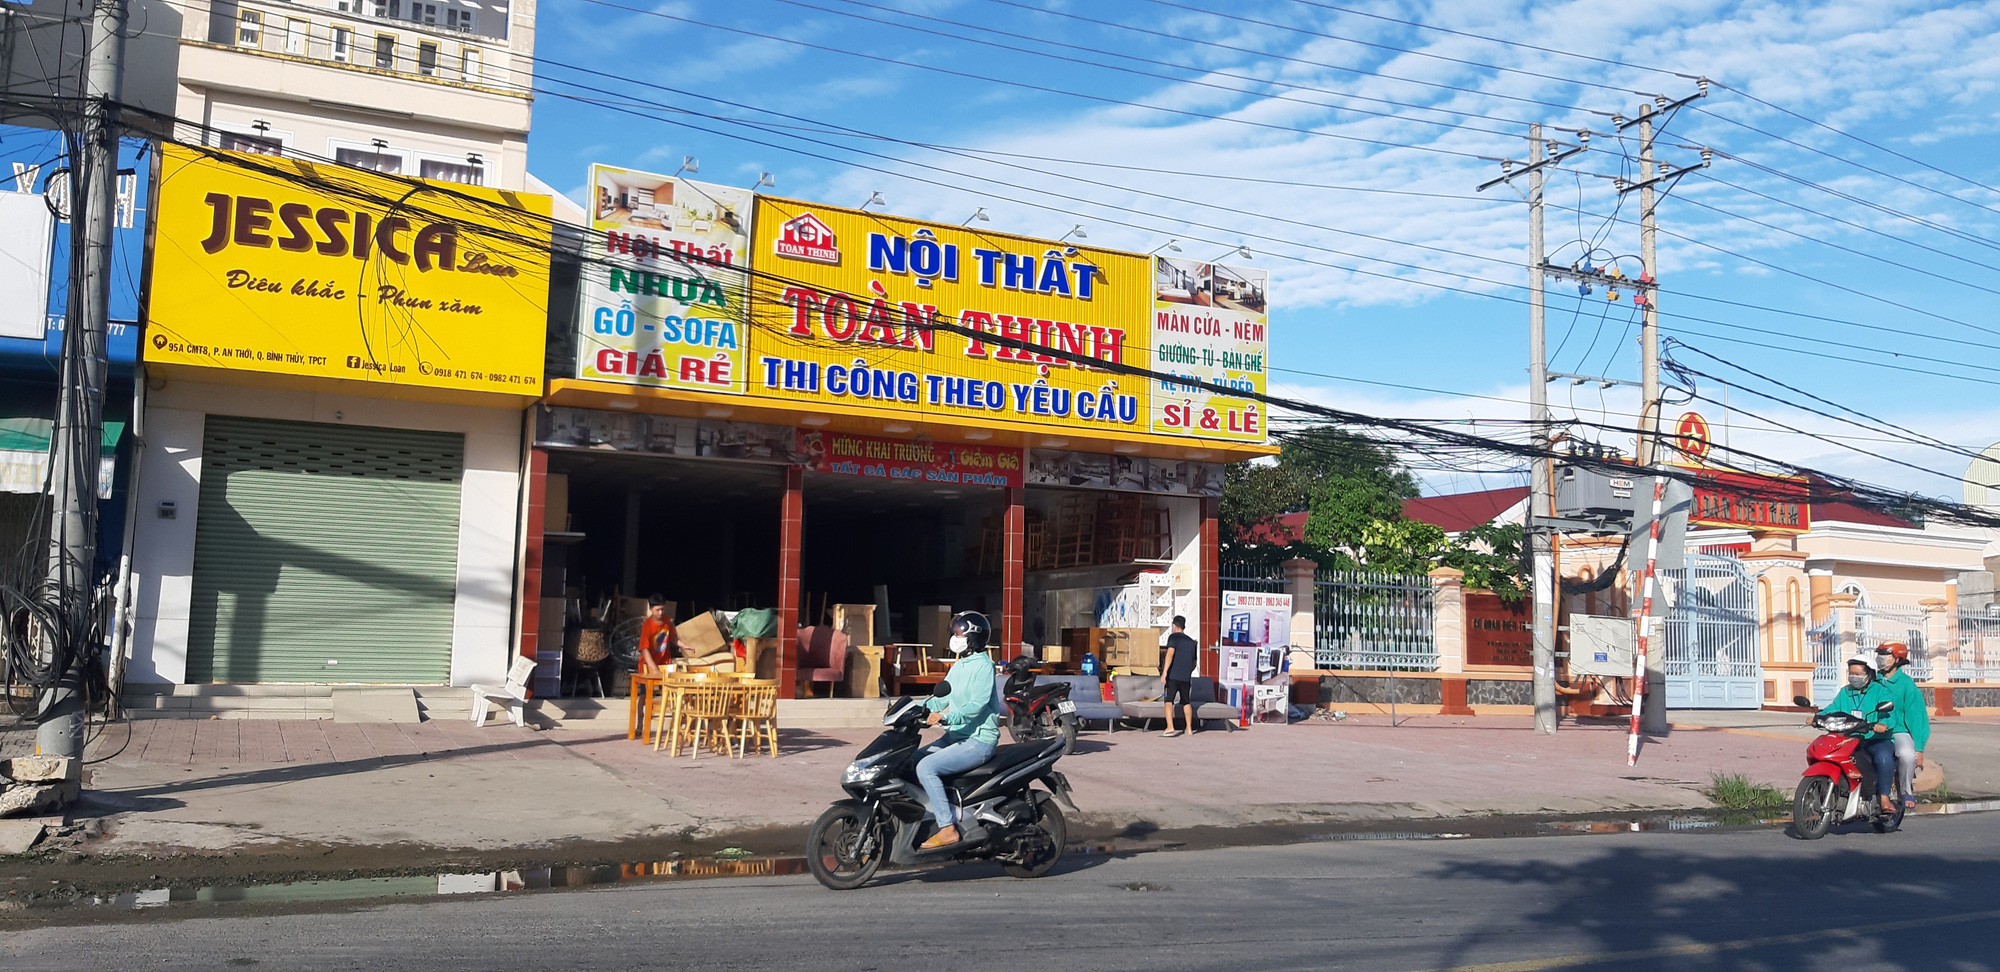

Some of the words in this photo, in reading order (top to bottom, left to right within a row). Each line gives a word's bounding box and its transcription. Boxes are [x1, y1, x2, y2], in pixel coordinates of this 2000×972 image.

[200, 191, 457, 273] JESSICA
[457, 251, 519, 279] Loan
[606, 230, 659, 262] Nội
[669, 238, 734, 269] Thất
[780, 243, 805, 254] TOAN
[867, 228, 959, 288] NỘI
[971, 246, 1099, 301] THẤT
[290, 278, 346, 300] khắc
[377, 284, 432, 310] Phun
[438, 298, 483, 315] xăm
[609, 267, 728, 307] NHỰA
[593, 299, 635, 338] GỖ
[643, 323, 655, 331] -
[663, 315, 738, 349] SOFA
[783, 279, 937, 351] TOÀN
[957, 309, 1126, 376] THỊNH
[1157, 310, 1189, 333] MÀN
[1194, 312, 1221, 337] CỬA
[1234, 319, 1264, 345] NỆM
[168, 342, 184, 353] 95A
[187, 344, 211, 356] CMT8,
[213, 347, 221, 357] P.
[222, 348, 233, 357] AN
[235, 348, 255, 360] THỚI,
[257, 351, 264, 361] Q.
[266, 350, 283, 362] BÌNH
[308, 356, 327, 366] TPCT
[361, 359, 387, 372] Jessica
[390, 362, 406, 373] Loan
[596, 348, 668, 379] GIÁ
[679, 353, 732, 386] RẺ
[1202, 344, 1214, 367] TỦ
[1222, 349, 1242, 370] BÀN
[1244, 350, 1263, 372] GHẾ
[434, 367, 452, 378] 0918
[454, 369, 467, 379] 471
[470, 371, 483, 380] 674
[488, 373, 507, 383] 0982
[508, 375, 521, 384] 471
[523, 376, 536, 385] 674
[760, 356, 819, 393] THI
[825, 358, 919, 402] CÔNG
[923, 374, 1005, 411] THEO
[1009, 378, 1073, 418] YÊU
[1075, 379, 1138, 423] CẦU
[1163, 398, 1192, 427] SỈ
[1199, 408, 1220, 430] &
[1228, 404, 1259, 434] LẺ
[865, 440, 891, 460] KHAI
